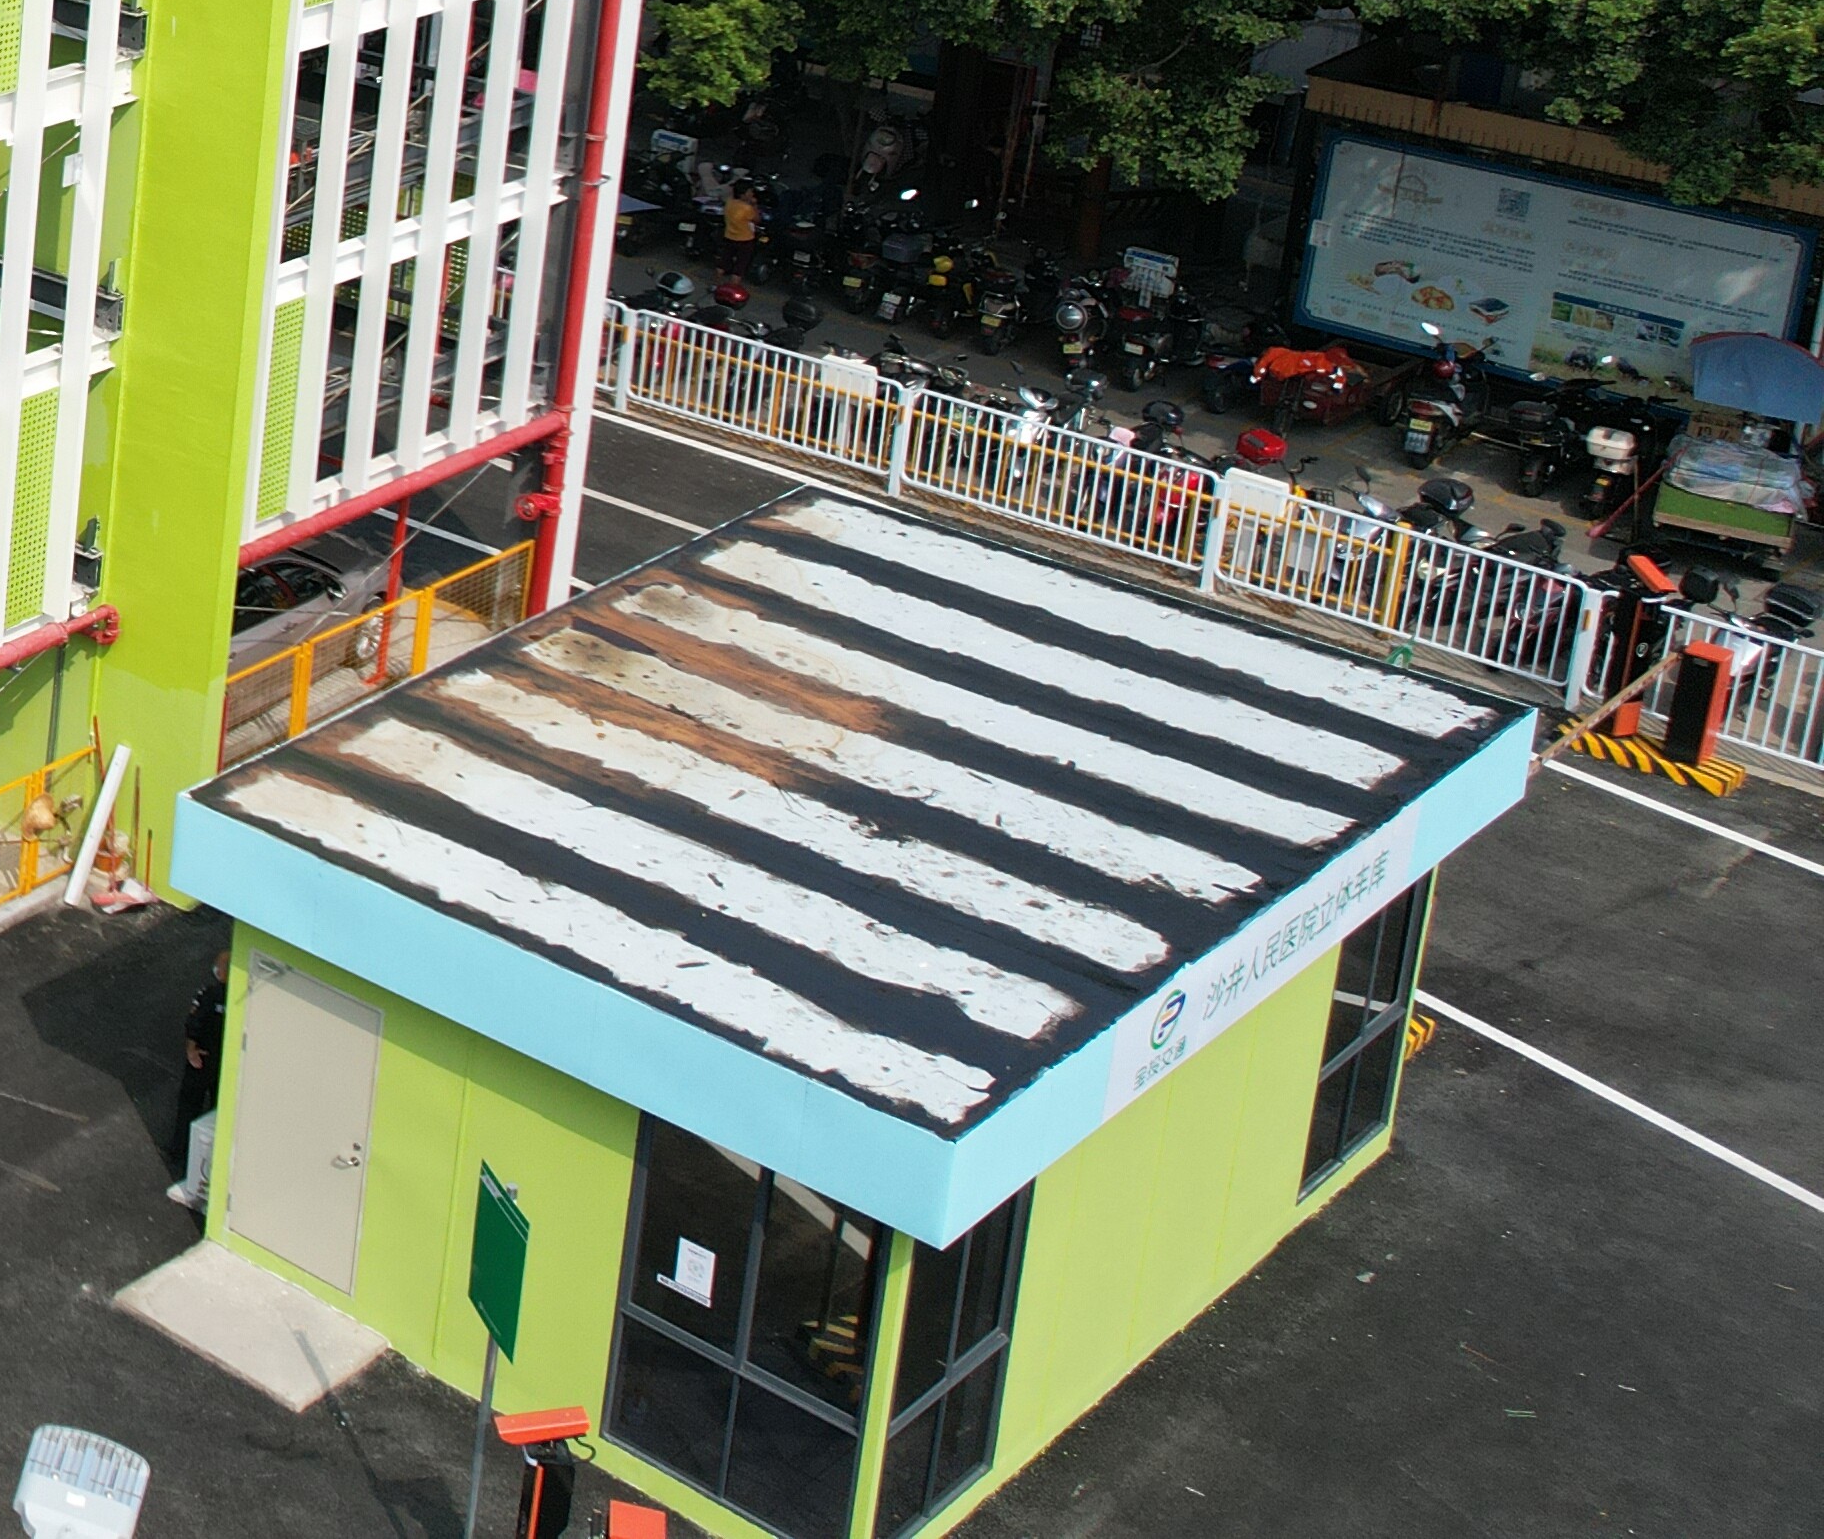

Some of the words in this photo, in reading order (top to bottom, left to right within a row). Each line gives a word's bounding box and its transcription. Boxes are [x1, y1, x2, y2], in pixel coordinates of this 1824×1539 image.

[1203, 850, 1389, 1021] 沙井人民医院立体车库
